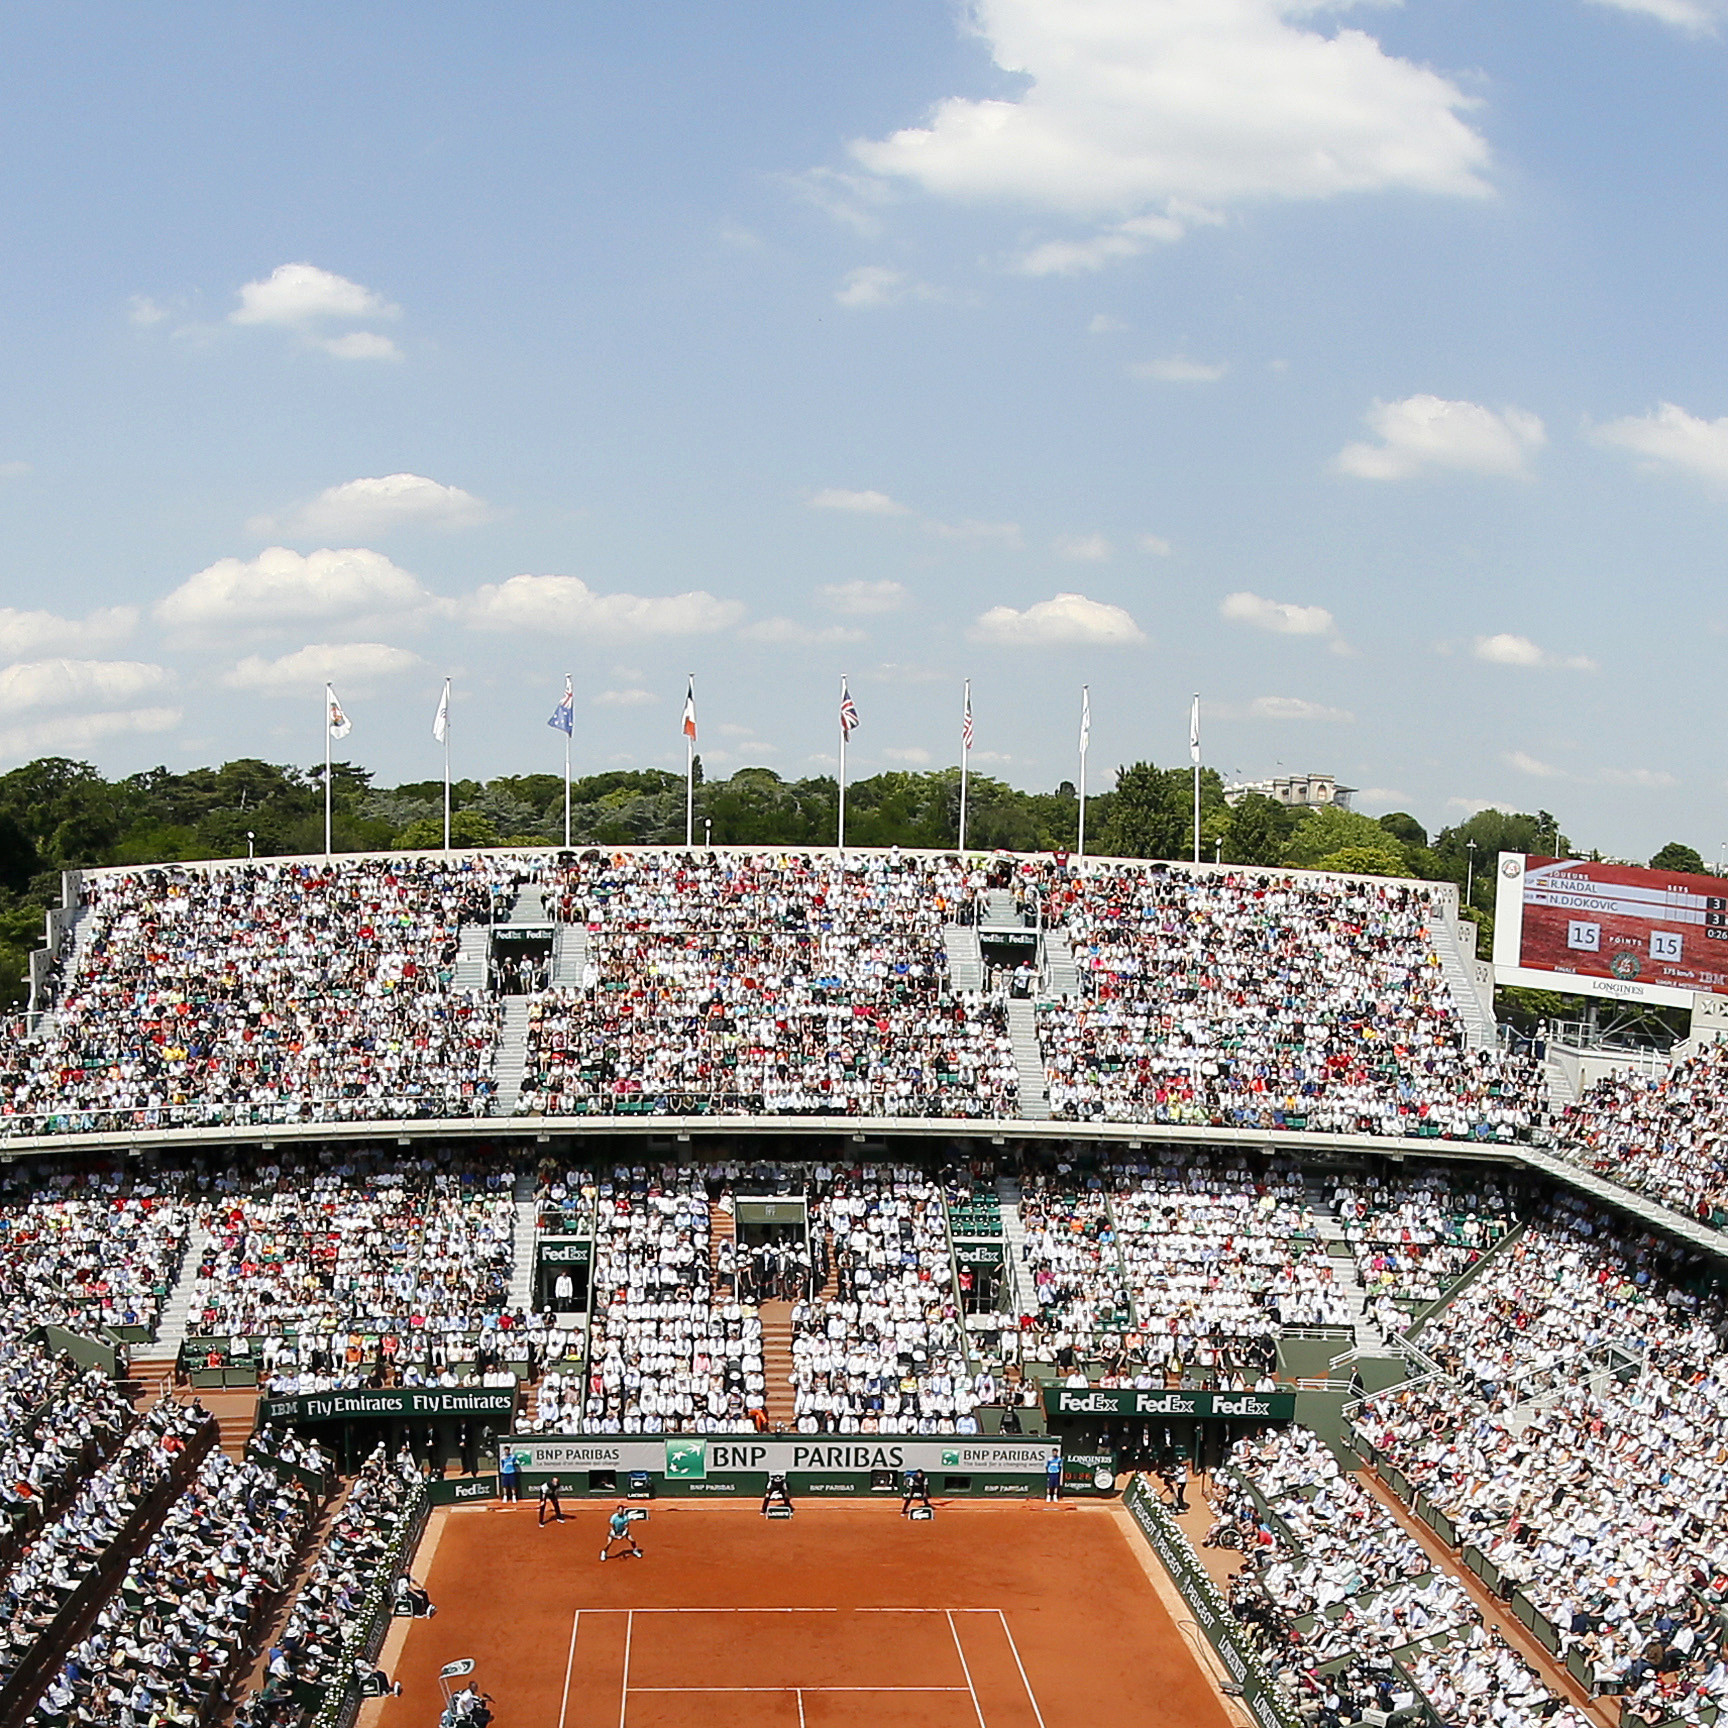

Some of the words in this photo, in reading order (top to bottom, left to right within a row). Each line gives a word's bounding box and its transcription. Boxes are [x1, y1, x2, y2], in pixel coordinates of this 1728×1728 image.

[1550, 880, 1598, 893] R.NADAL
[1713, 899, 1721, 909] 3
[1667, 884, 1688, 893] SETS
[1549, 895, 1618, 911] N.DJOKOVIC
[1712, 914, 1719, 924] 3
[1573, 927, 1595, 944] 15
[1609, 936, 1642, 946] POINTS
[1708, 929, 1728, 939] 0:26
[1656, 938, 1677, 954] 15
[1699, 971, 1726, 985] IBM
[1593, 981, 1644, 995] LONGINES
[542, 1246, 588, 1261] FedEx
[955, 1247, 1000, 1262] FedEx
[271, 1401, 298, 1417] IBM
[307, 1400, 332, 1416] Fly
[334, 1396, 403, 1412] Emirates
[413, 1395, 440, 1412] Fly
[442, 1393, 512, 1409] Emirates
[1060, 1392, 1118, 1412] FedEx
[1136, 1394, 1194, 1413] FedEx
[1212, 1395, 1270, 1415] FedEx
[536, 1449, 563, 1460] BNP
[566, 1449, 620, 1460] PARIBAS
[712, 1446, 767, 1468] BNP
[793, 1446, 904, 1468] PARIBAS
[963, 1450, 989, 1461] BNP
[993, 1450, 1046, 1462] PARIBAS
[1068, 1455, 1112, 1464] LONGINES
[455, 1482, 491, 1497] FedEx
[1134, 1499, 1157, 1535] PEUGEOT
[1158, 1537, 1183, 1577] PEUGEOT
[1187, 1584, 1215, 1629] PEUGEOT
[1218, 1634, 1248, 1683] LONGINES
